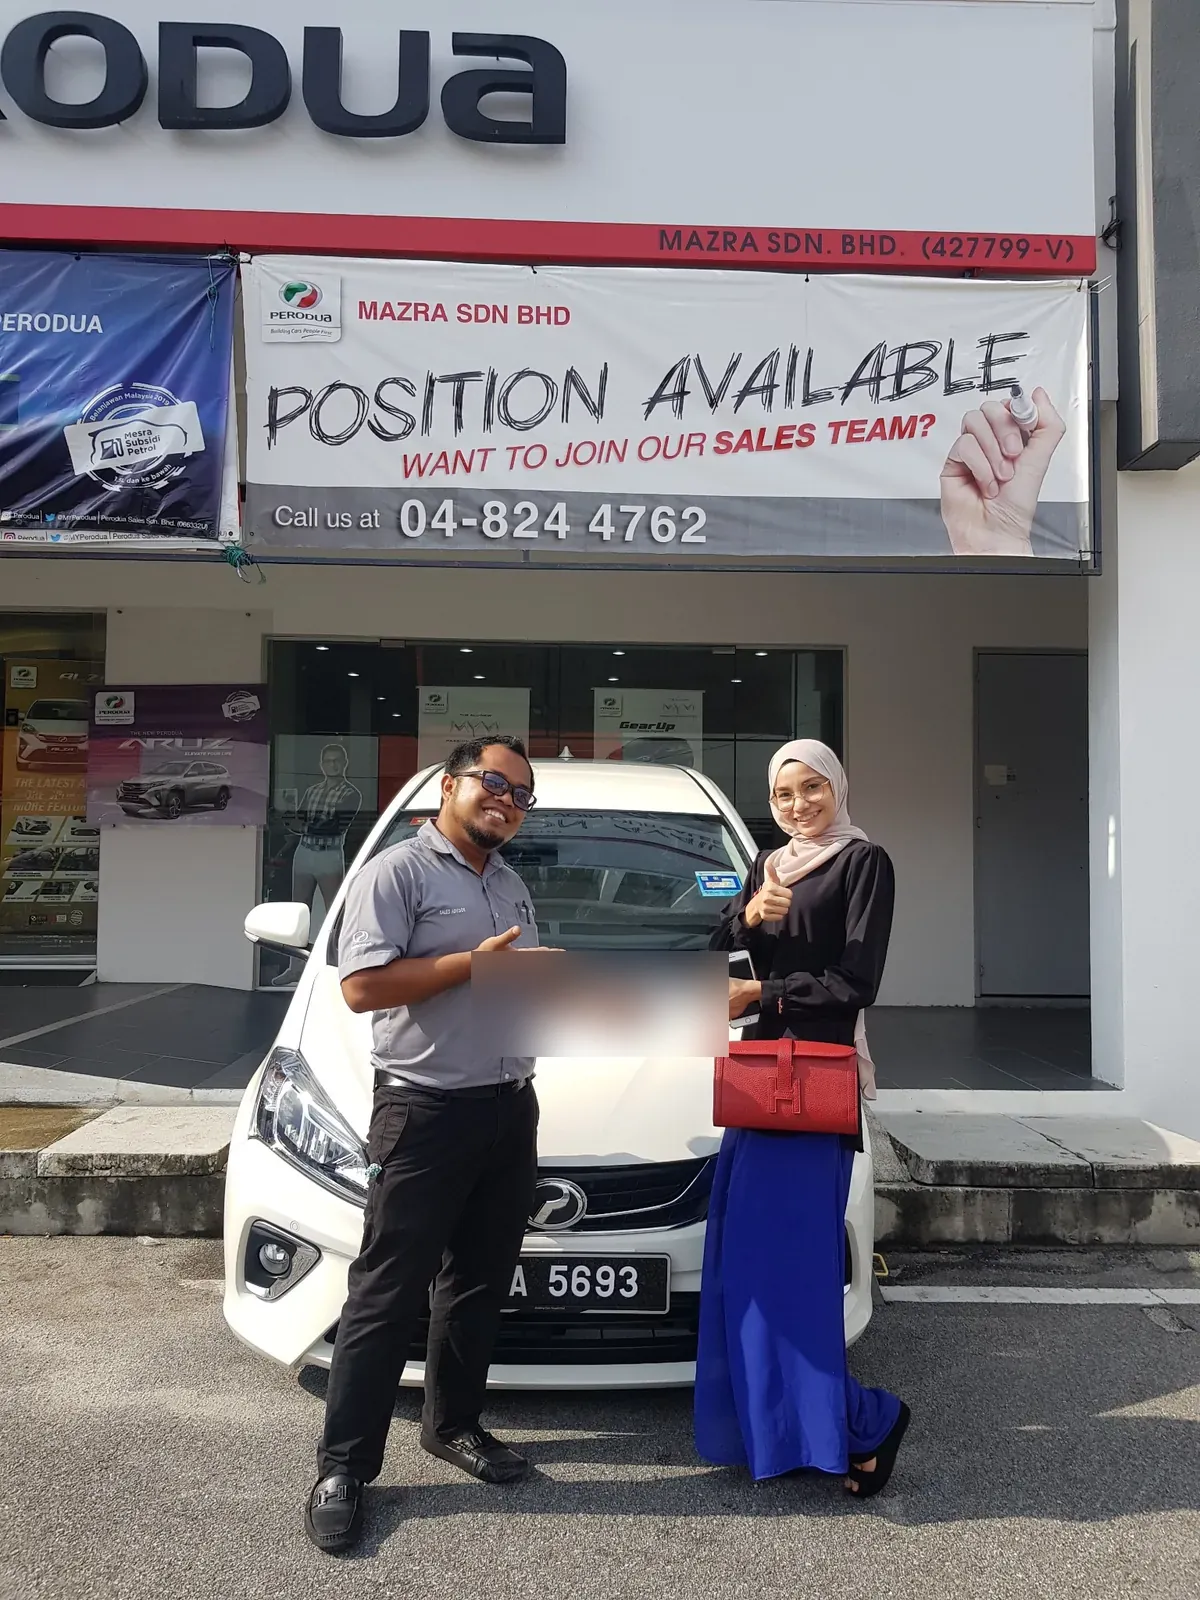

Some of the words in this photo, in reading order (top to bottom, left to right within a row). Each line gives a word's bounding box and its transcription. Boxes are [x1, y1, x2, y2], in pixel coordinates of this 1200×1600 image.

[658, 229, 759, 253] MAZRA
[767, 232, 832, 254] SDN.
[841, 234, 905, 257] BHD.
[921, 236, 1074, 263] (427799-V)
[0, 313, 103, 333] ERODUA
[357, 300, 448, 322] MAZRA
[456, 303, 509, 324] SDN
[517, 305, 571, 326] BHD
[263, 362, 608, 450] POSITION
[642, 331, 1030, 420] AVAILABLE
[90, 395, 123, 421] Belanjawan
[124, 392, 154, 401] Malaysia
[154, 394, 170, 406] 2019
[124, 428, 153, 439] Mesra
[126, 435, 161, 448] Subsidi
[127, 444, 157, 456] Petrol
[402, 447, 497, 479] WANT
[506, 444, 548, 471] TO
[555, 438, 629, 468] JOIN
[637, 433, 707, 461] OUR
[713, 423, 816, 455] SALES
[827, 413, 936, 445] TEAM?
[126, 474, 140, 484] dan
[151, 463, 172, 480] bawah
[128, 516, 145, 524] Sales
[274, 506, 318, 528] Call
[326, 511, 353, 528] us
[359, 509, 380, 528] at
[400, 499, 570, 539] 04-824
[588, 503, 707, 544] 4762
[619, 721, 676, 733] GearUp
[37, 778, 76, 789] LATEST
[548, 1265, 639, 1298] 5693
